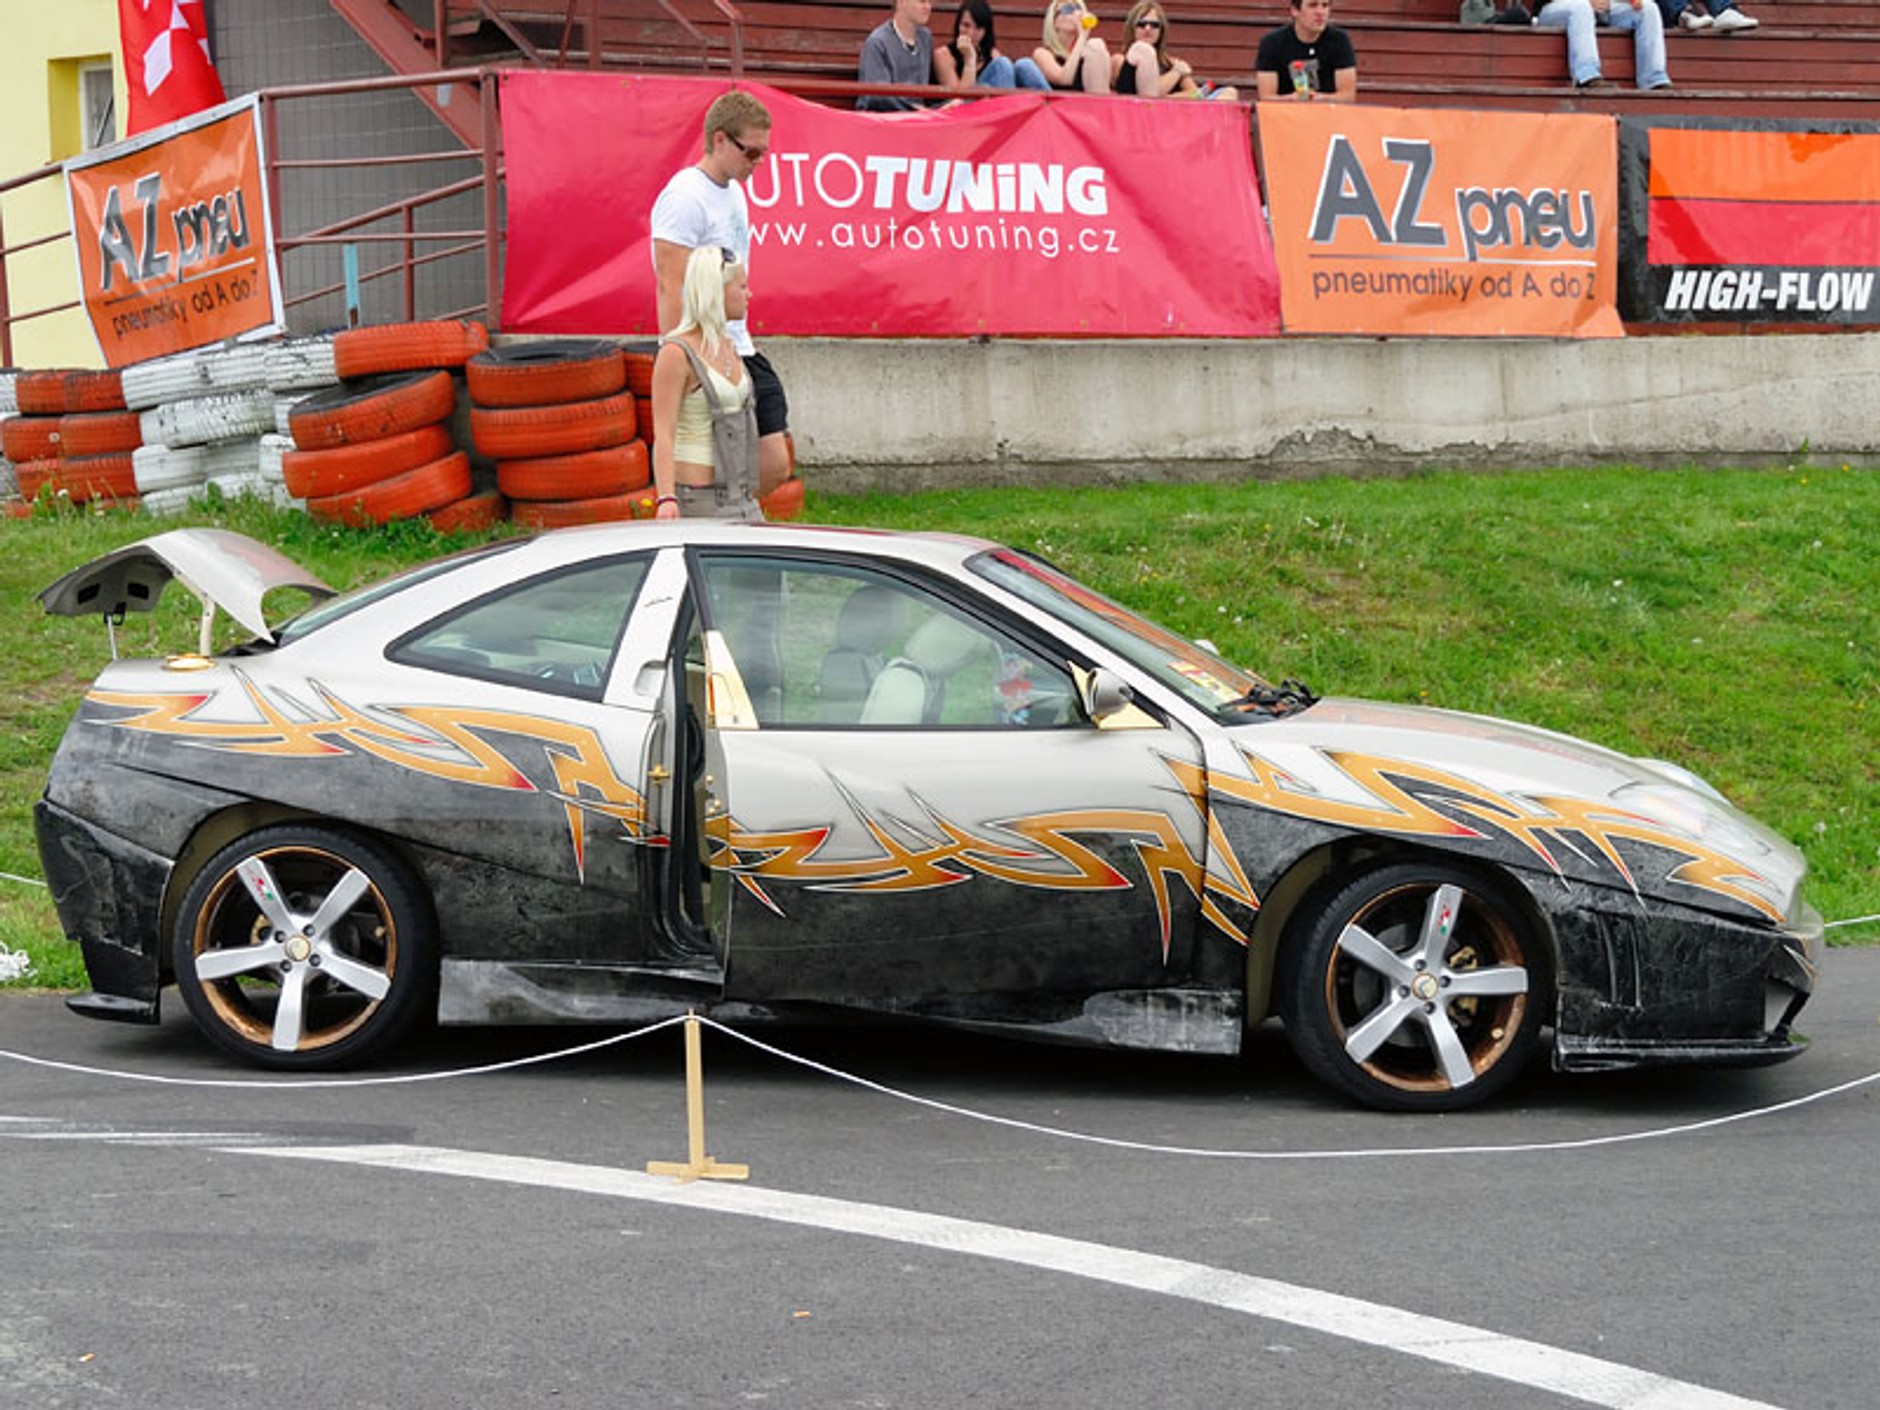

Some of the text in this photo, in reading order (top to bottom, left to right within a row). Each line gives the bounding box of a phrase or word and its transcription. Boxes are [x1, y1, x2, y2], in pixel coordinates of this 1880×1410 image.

[746, 152, 1108, 215] UTOTUNiNG
[1308, 134, 1596, 262] AZ pneu
[100, 171, 250, 291] AZ pneu
[748, 217, 1121, 258] ww.autotuning.cz
[112, 295, 188, 340] pneumatiky
[191, 285, 215, 314] od
[216, 282, 229, 307] A
[230, 275, 250, 302] do
[1312, 268, 1596, 301] pneumatiky od A do Z
[1664, 270, 1875, 311] HIGH-FLOW
